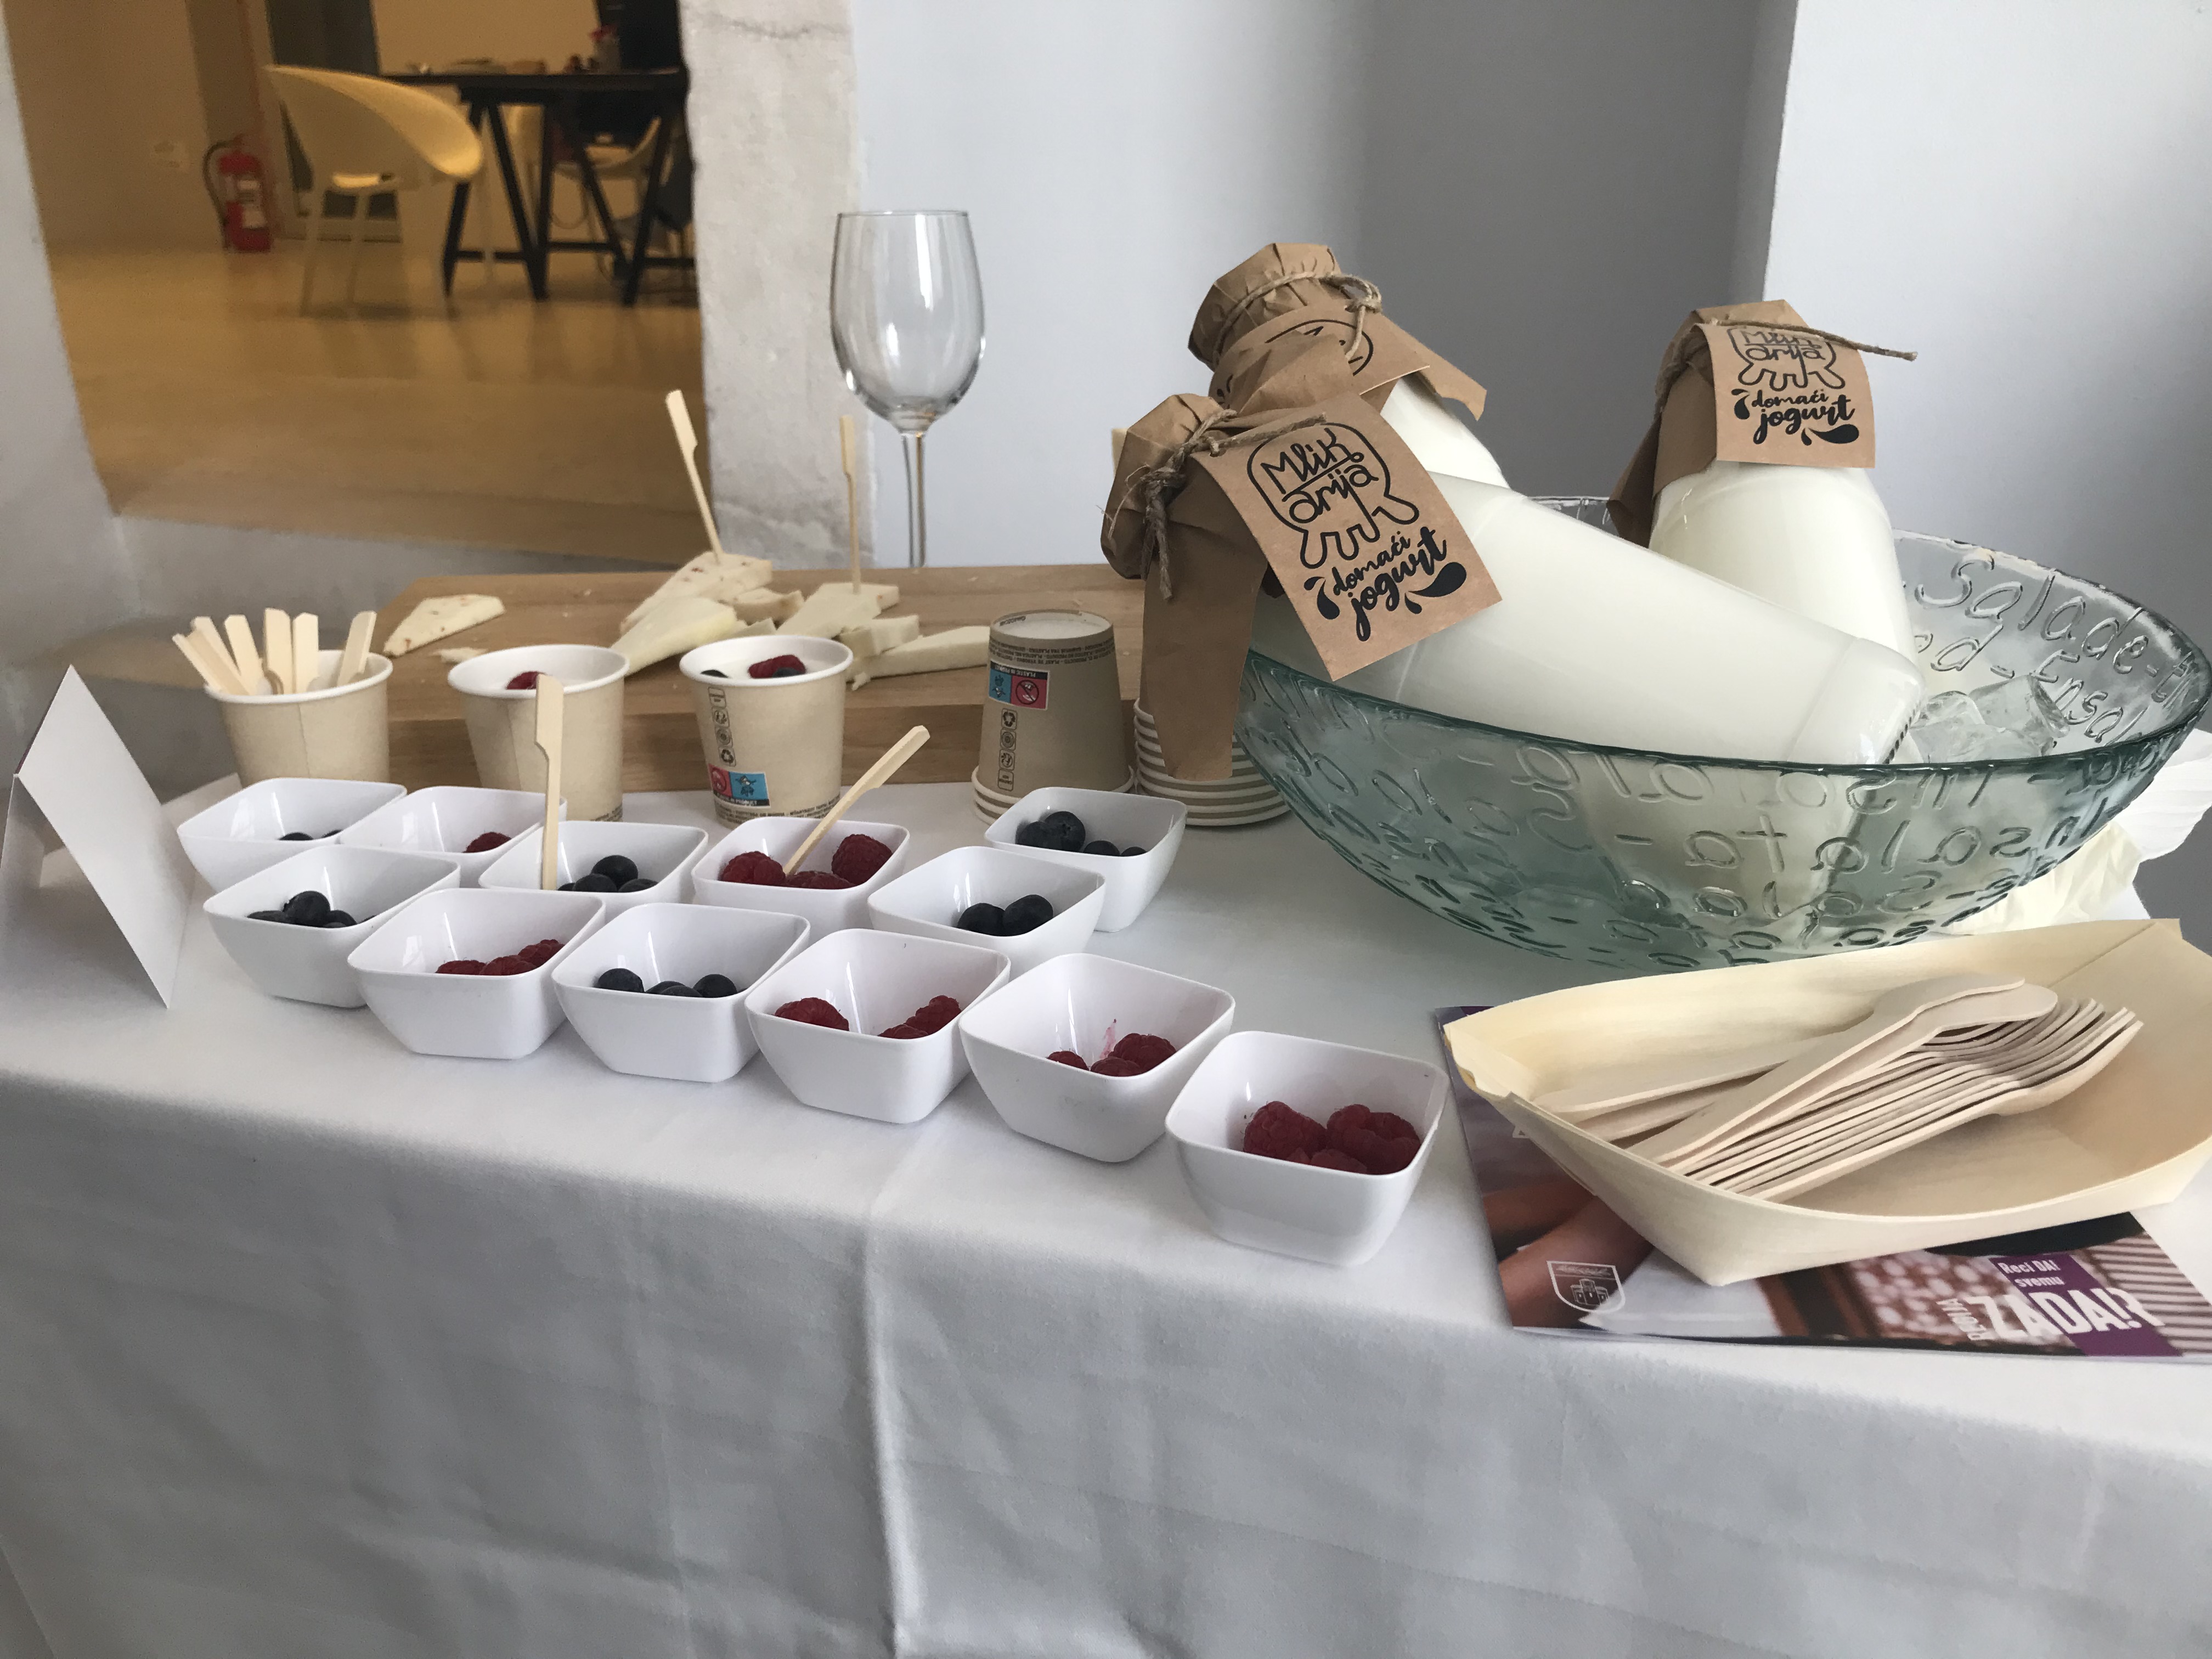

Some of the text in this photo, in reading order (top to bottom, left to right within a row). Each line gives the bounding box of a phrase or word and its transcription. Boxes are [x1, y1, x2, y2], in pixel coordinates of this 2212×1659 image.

[1751, 388, 1831, 408] domaći
[1753, 394, 1855, 445] jogurt
[1332, 531, 1411, 596] domaći
[1348, 527, 1447, 642] jogurt
